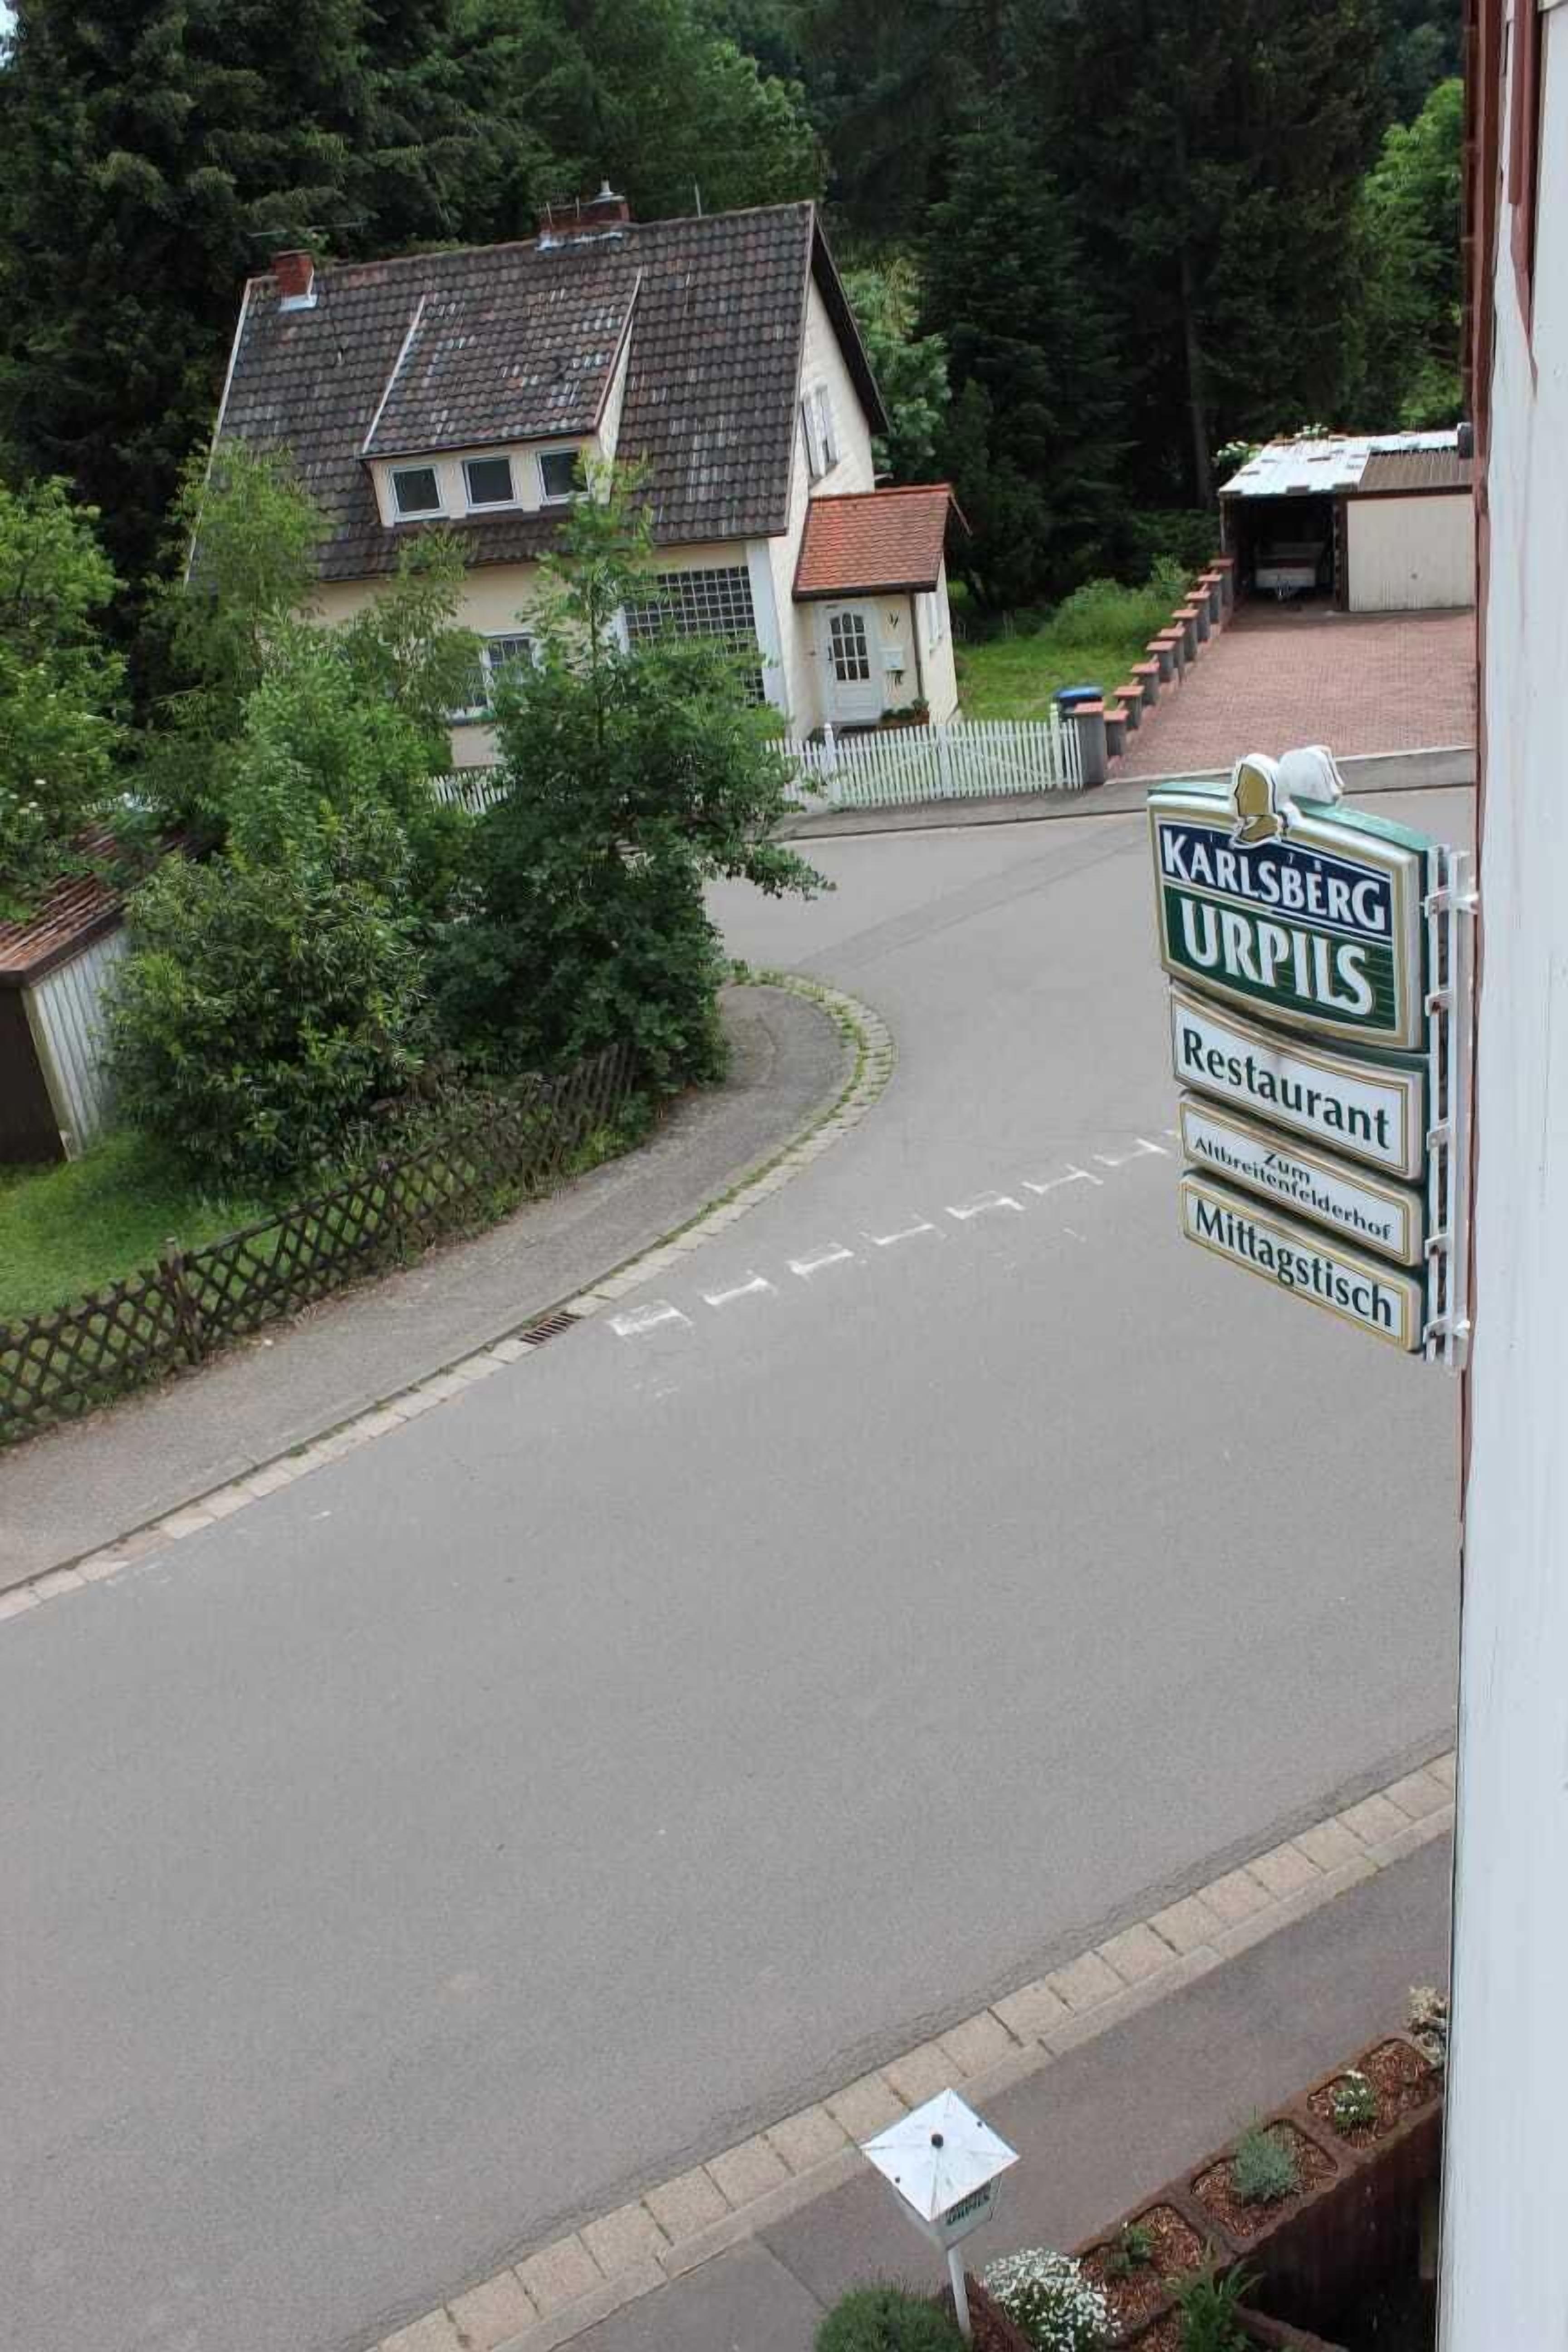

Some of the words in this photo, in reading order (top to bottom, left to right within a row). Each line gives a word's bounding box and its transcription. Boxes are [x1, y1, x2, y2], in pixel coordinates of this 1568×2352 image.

[1163, 828, 1385, 931] KARLSBERG
[1181, 899, 1372, 1014] URPILS
[1183, 1029, 1389, 1149] Restaurant
[1195, 1137, 1392, 1240] Altbreitenfelderhof
[1264, 1151, 1310, 1185] Zum
[1195, 1199, 1392, 1327] Mittagstisch
